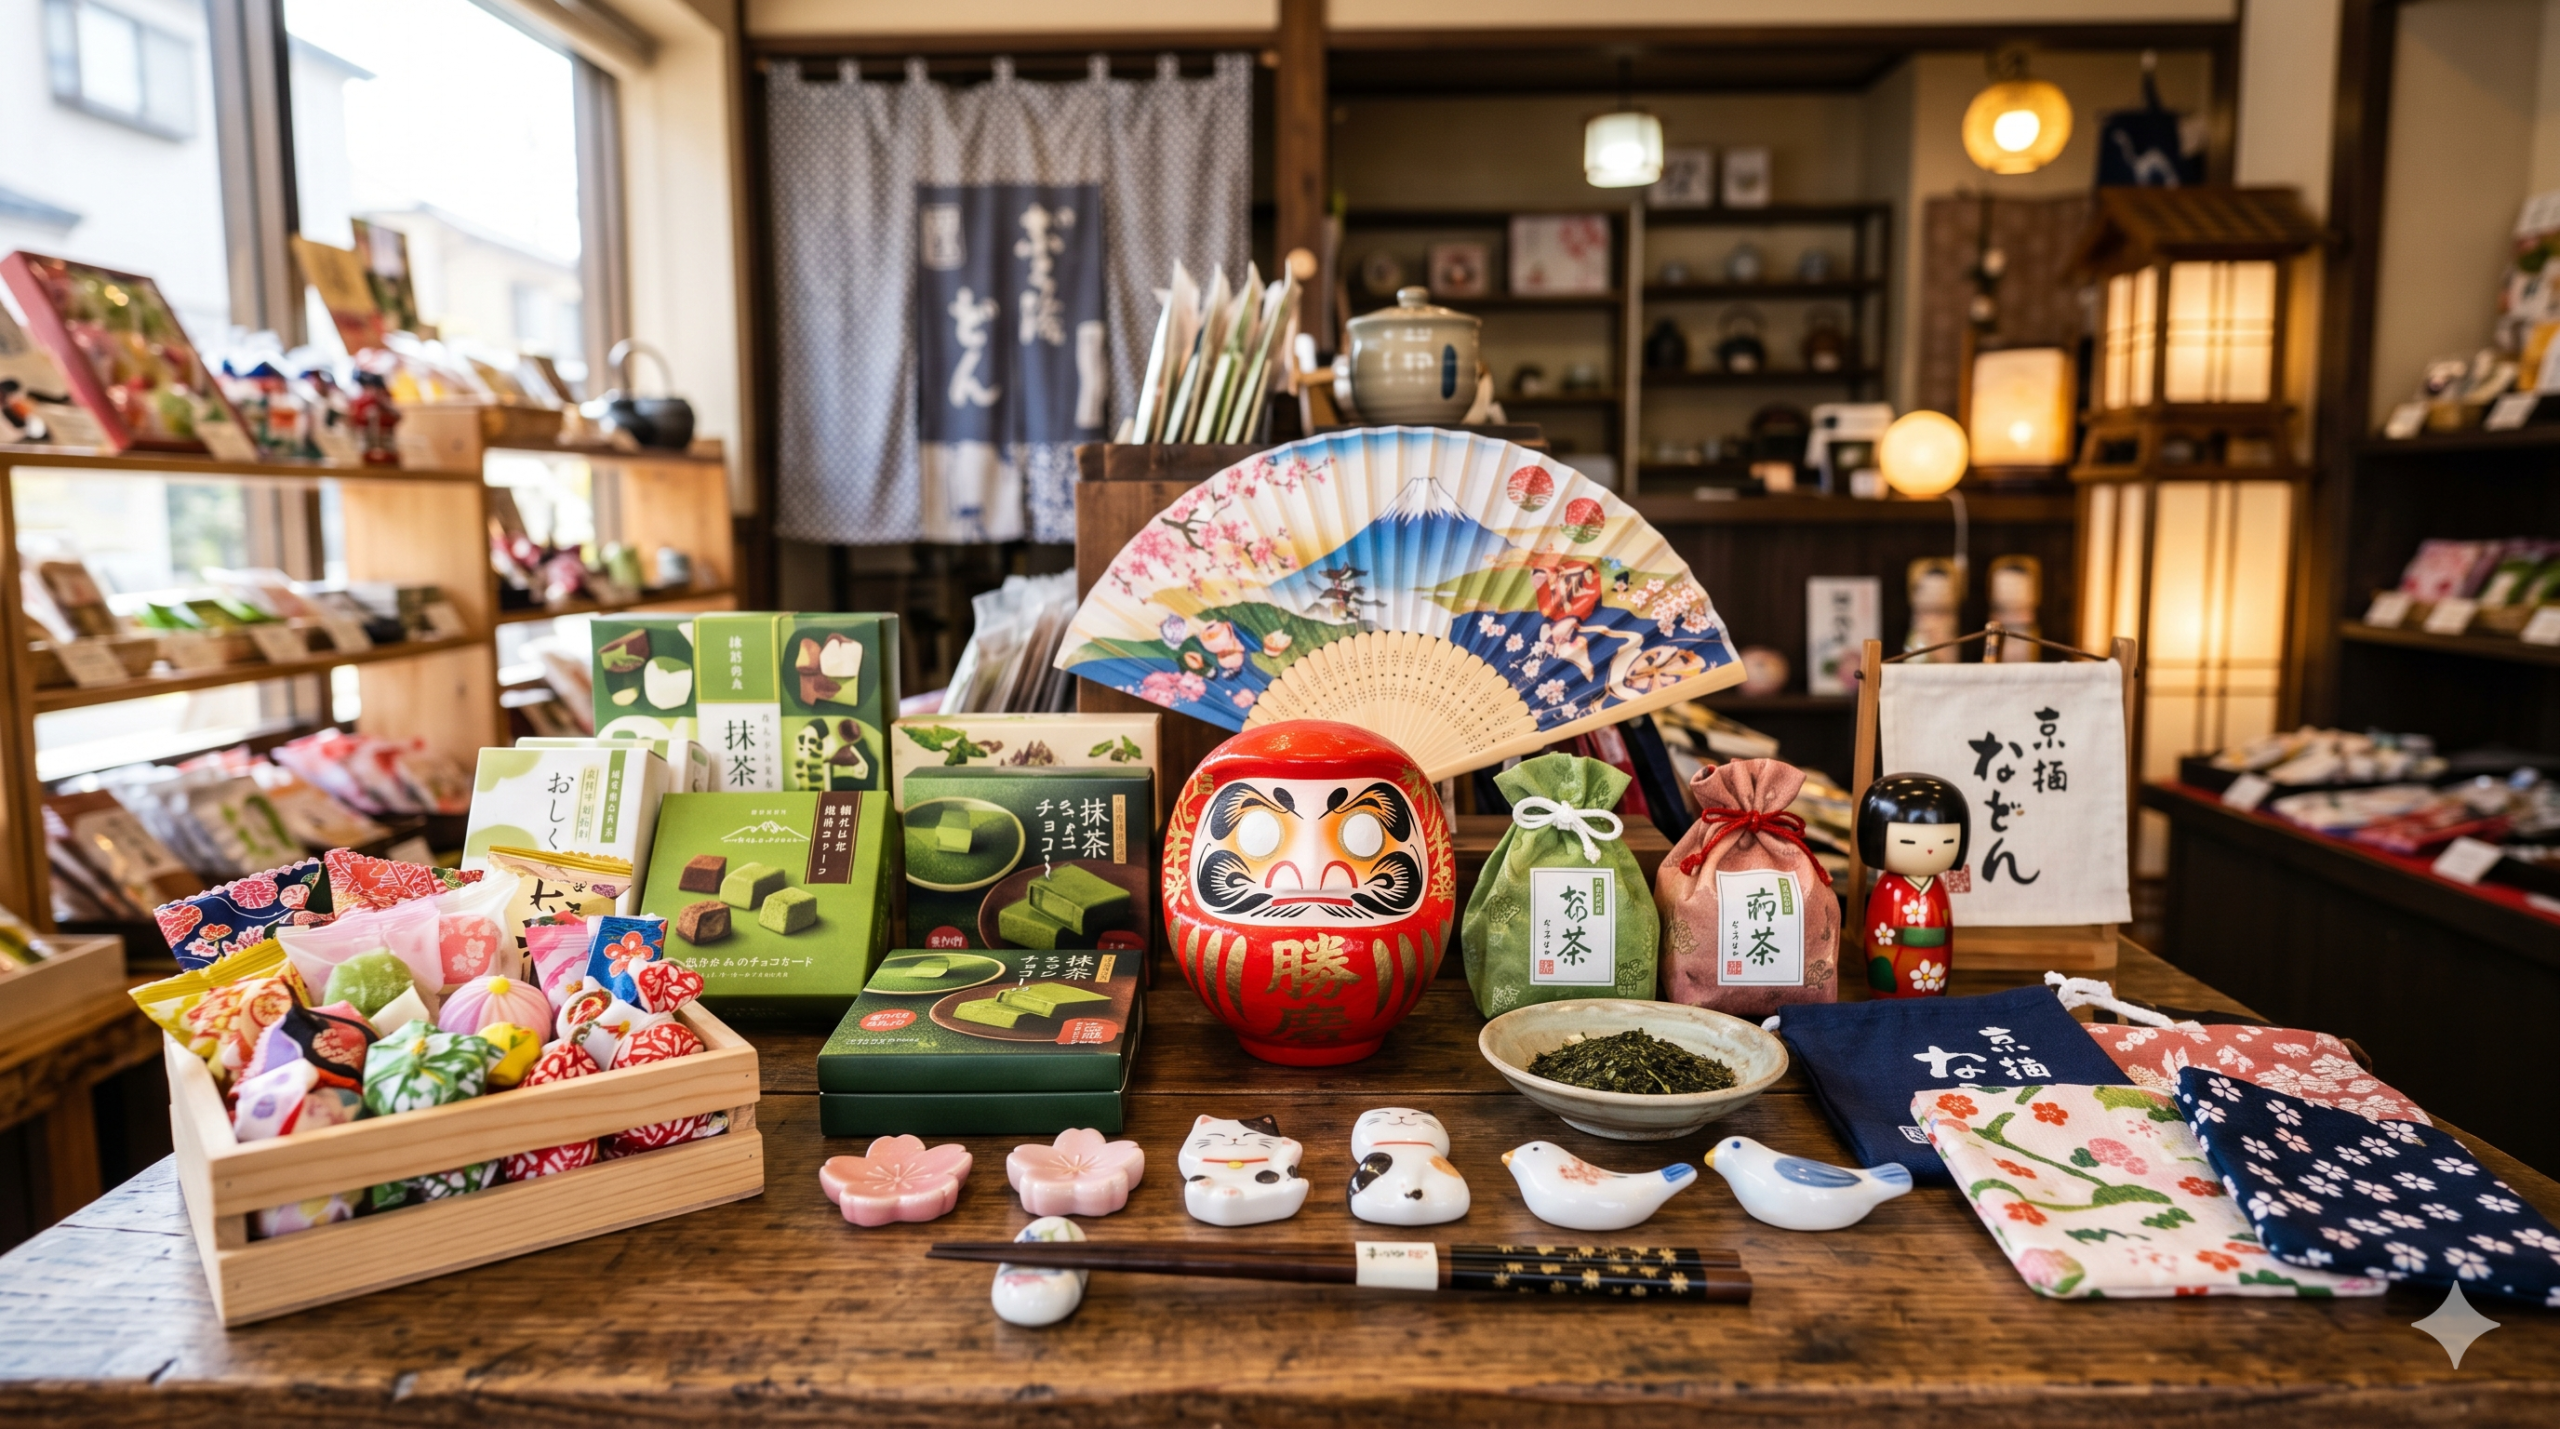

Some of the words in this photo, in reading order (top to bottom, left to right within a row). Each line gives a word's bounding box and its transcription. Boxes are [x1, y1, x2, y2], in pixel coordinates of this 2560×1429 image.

[724, 719, 757, 787] 抹茶
[1079, 798, 1111, 859] 抹茶
[1967, 730, 2041, 885] などん
[1062, 955, 1095, 981] 抹茶
